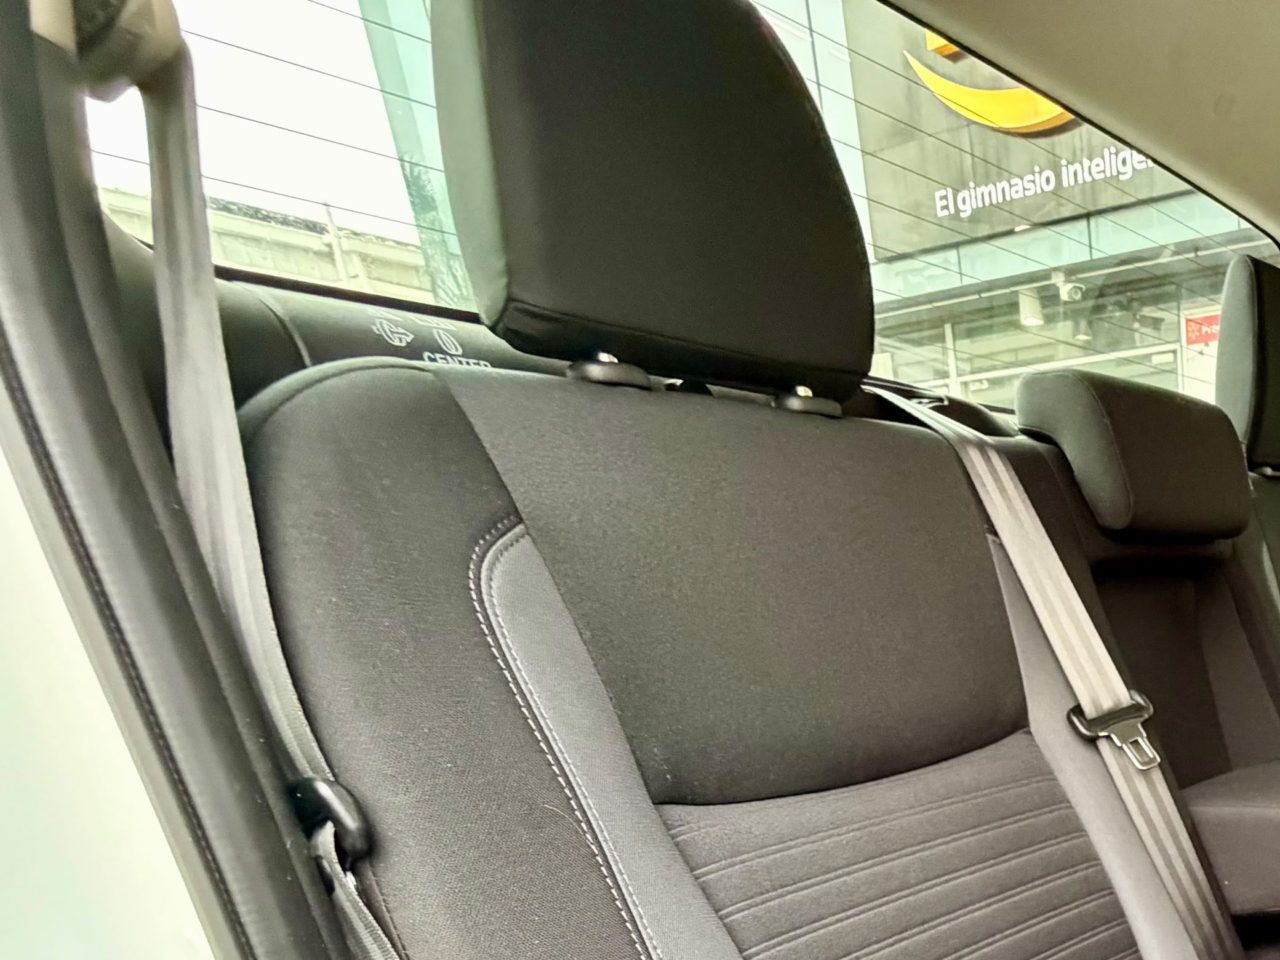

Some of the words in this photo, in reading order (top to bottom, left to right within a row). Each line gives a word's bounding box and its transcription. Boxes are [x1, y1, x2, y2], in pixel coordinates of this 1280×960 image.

[934, 187, 954, 218] El
[956, 165, 1056, 219] gimnasio
[1060, 146, 1155, 188] intelige
